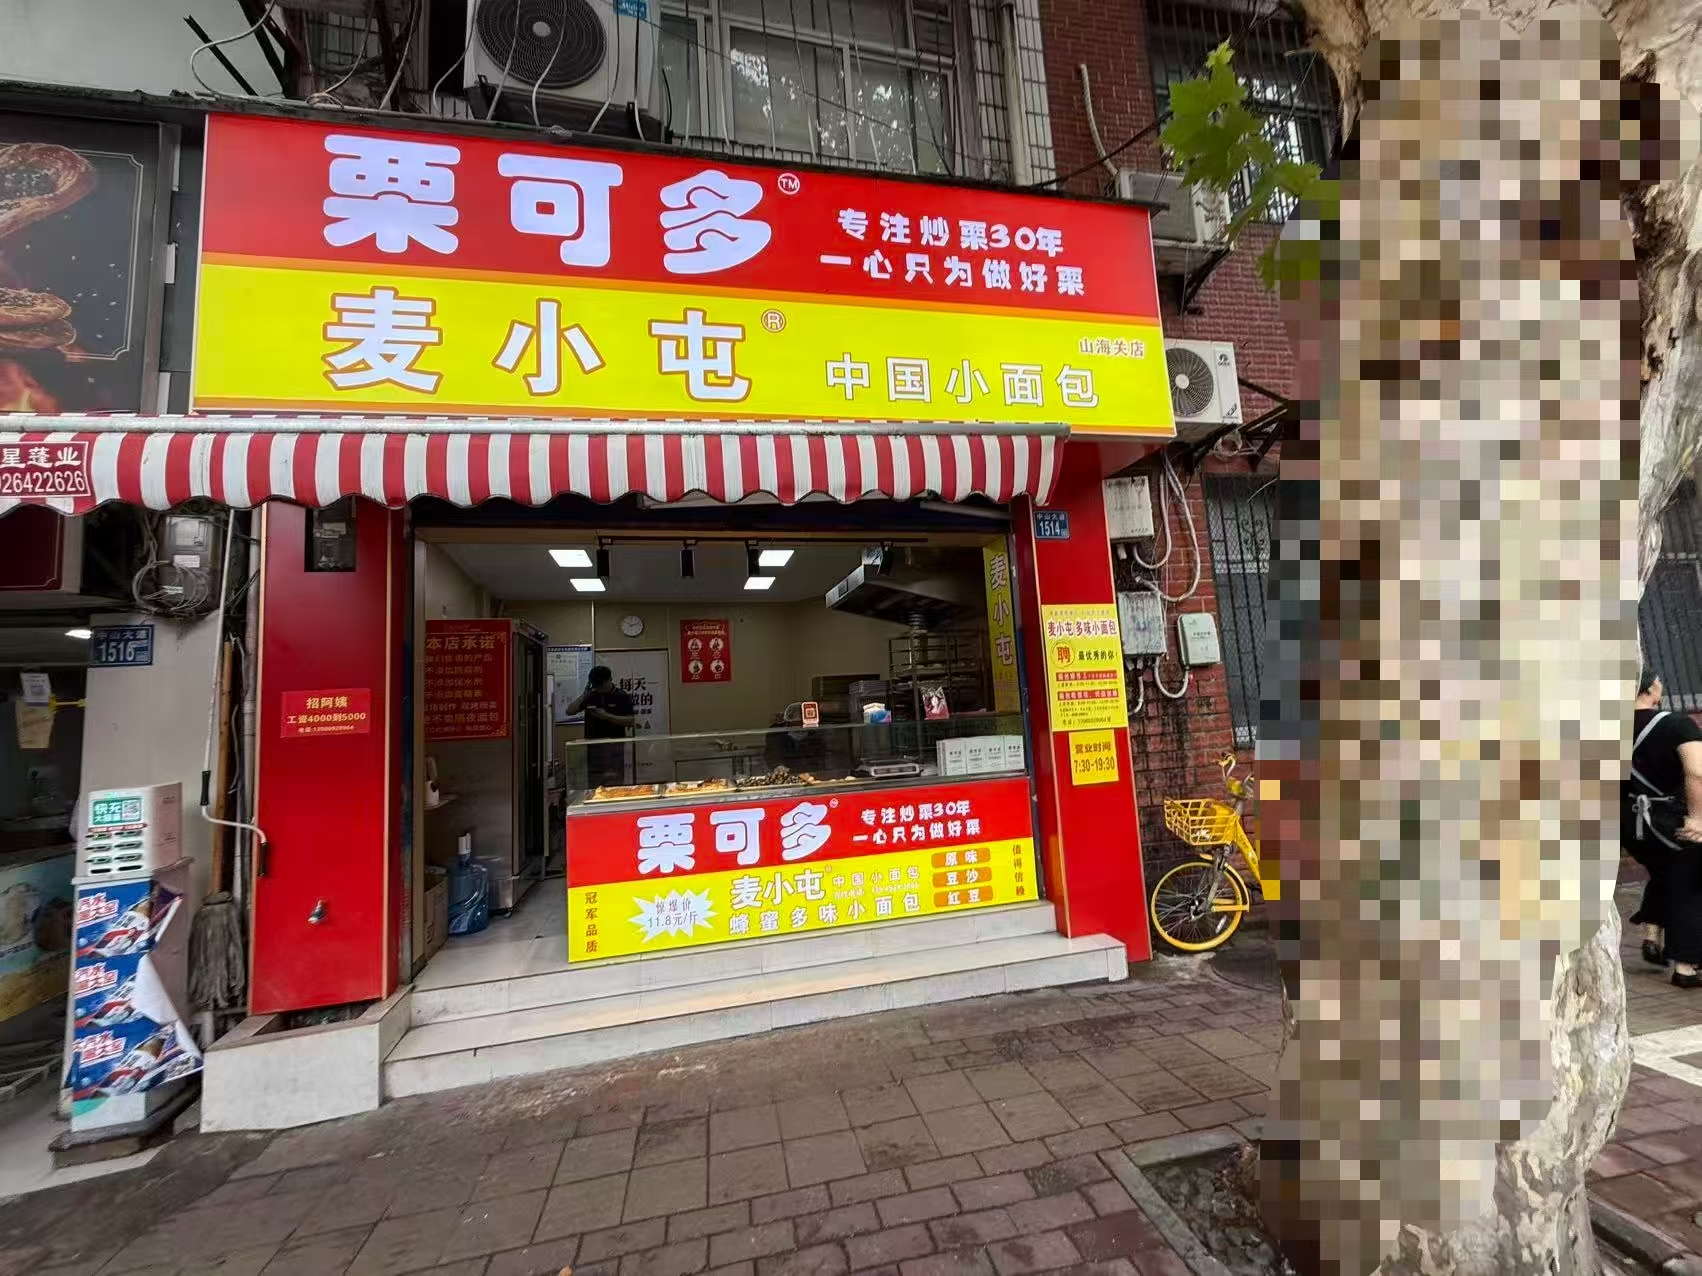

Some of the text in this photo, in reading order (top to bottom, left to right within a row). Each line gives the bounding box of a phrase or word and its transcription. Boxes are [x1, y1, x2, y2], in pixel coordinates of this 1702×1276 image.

[323, 133, 772, 273] 栗可多
[837, 208, 1063, 257] 专注炒栗30年
[820, 249, 1085, 296] 一心只为做好栗
[321, 285, 752, 402] 麦小屯
[1079, 337, 1146, 359] 山海关店
[825, 352, 1100, 408] 中国小面包
[1039, 520, 1061, 537] 1514
[990, 555, 1014, 666] 麦小屯
[1047, 619, 1117, 637] 麦小屯 多味小面包
[96, 641, 135, 662] 1516
[426, 635, 497, 650] 本店承诺
[1056, 646, 1071, 663] 聘
[305, 696, 349, 710] 招阿姨
[287, 712, 367, 724] 工资4000到5000
[1075, 741, 1112, 755] 营业时间
[1074, 756, 1116, 774] 7:30-19:30
[861, 799, 971, 826] 专注炒栗30年
[636, 800, 832, 875] 栗可多
[852, 818, 981, 845] 一心只为做好栗
[944, 849, 979, 866] 原味
[832, 866, 920, 888] 中国小面包
[946, 868, 979, 886] 豆沙
[1012, 844, 1025, 897] 值得信赖
[730, 869, 827, 911] 麦小屯
[947, 888, 981, 906] 红豆
[584, 891, 599, 953] 冠军品质
[647, 910, 699, 929] 11.8元/斤
[729, 892, 921, 936] 蜂蜜多味小面包
